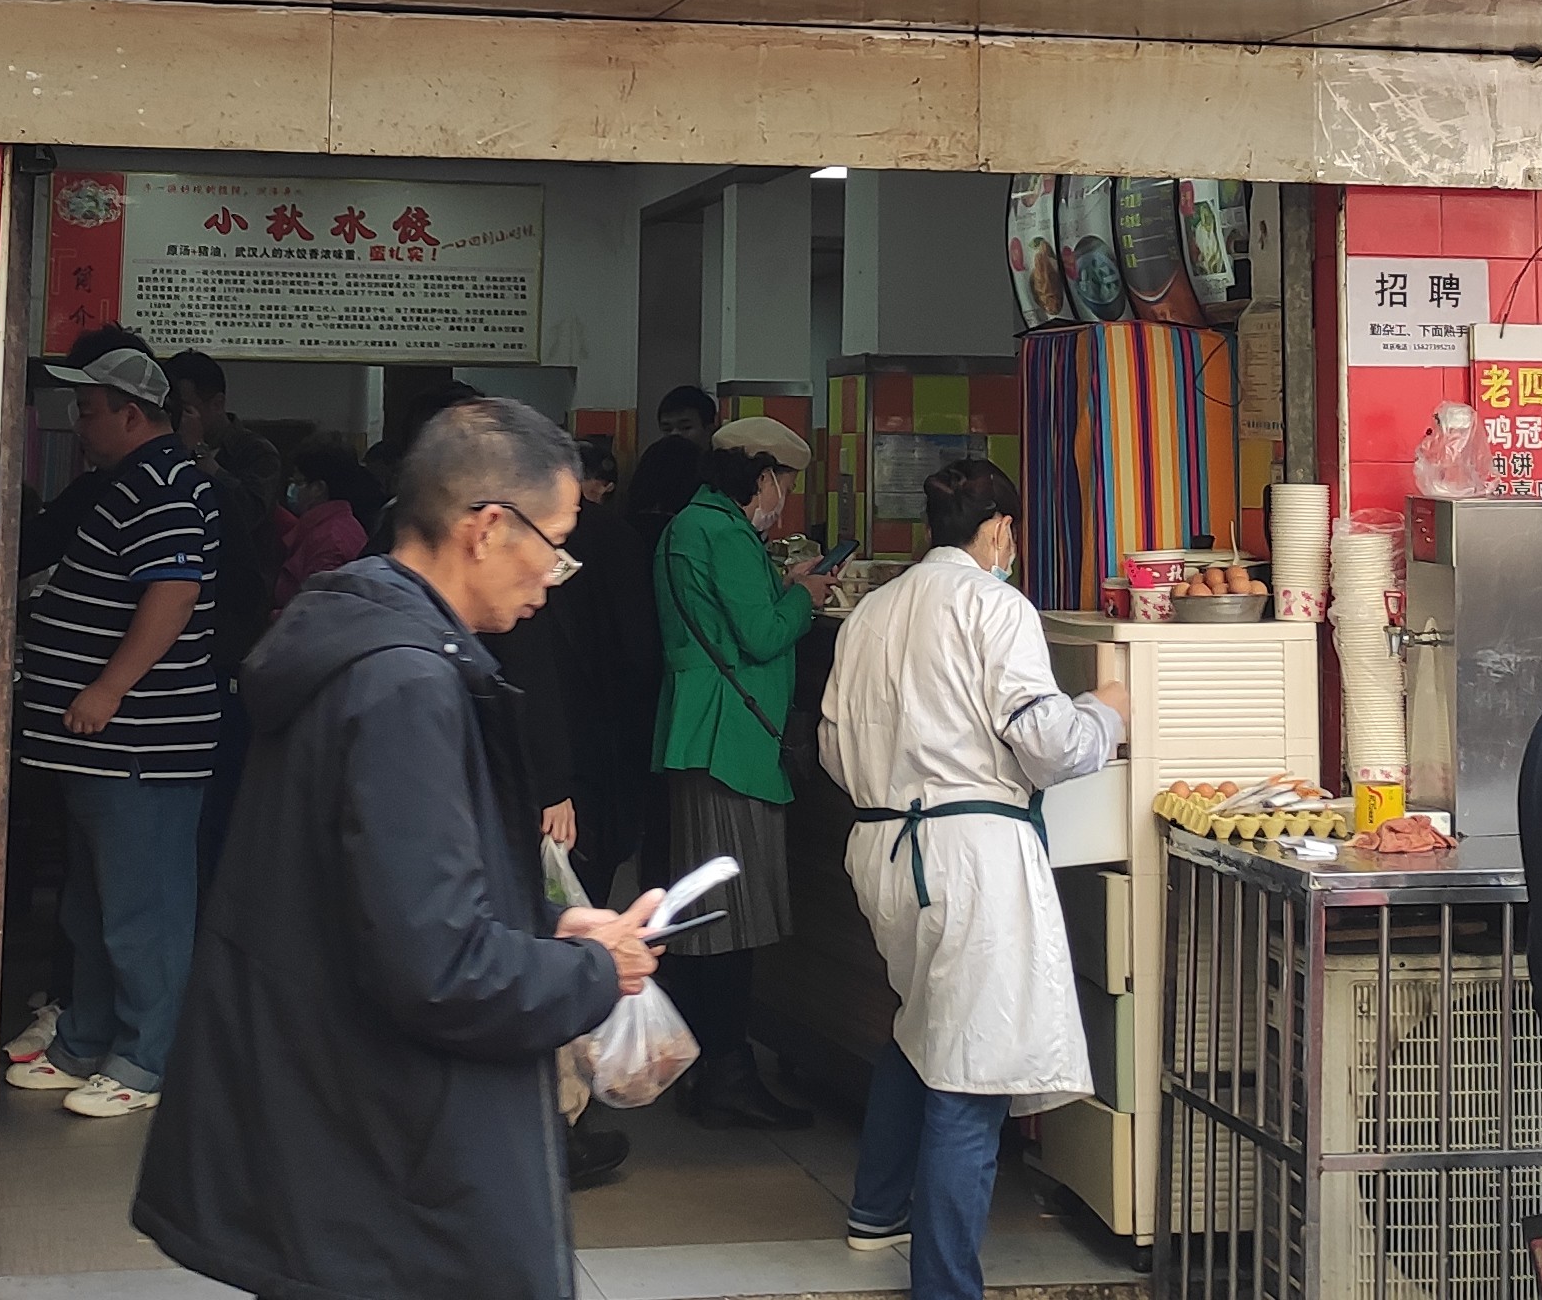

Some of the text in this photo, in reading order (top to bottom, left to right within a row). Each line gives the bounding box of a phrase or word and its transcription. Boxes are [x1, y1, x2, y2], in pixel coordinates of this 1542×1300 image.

[203, 204, 441, 246] 小秋水饺
[1375, 272, 1462, 308] 招聘
[1369, 323, 1468, 338] 勤杂工、下面熟手
